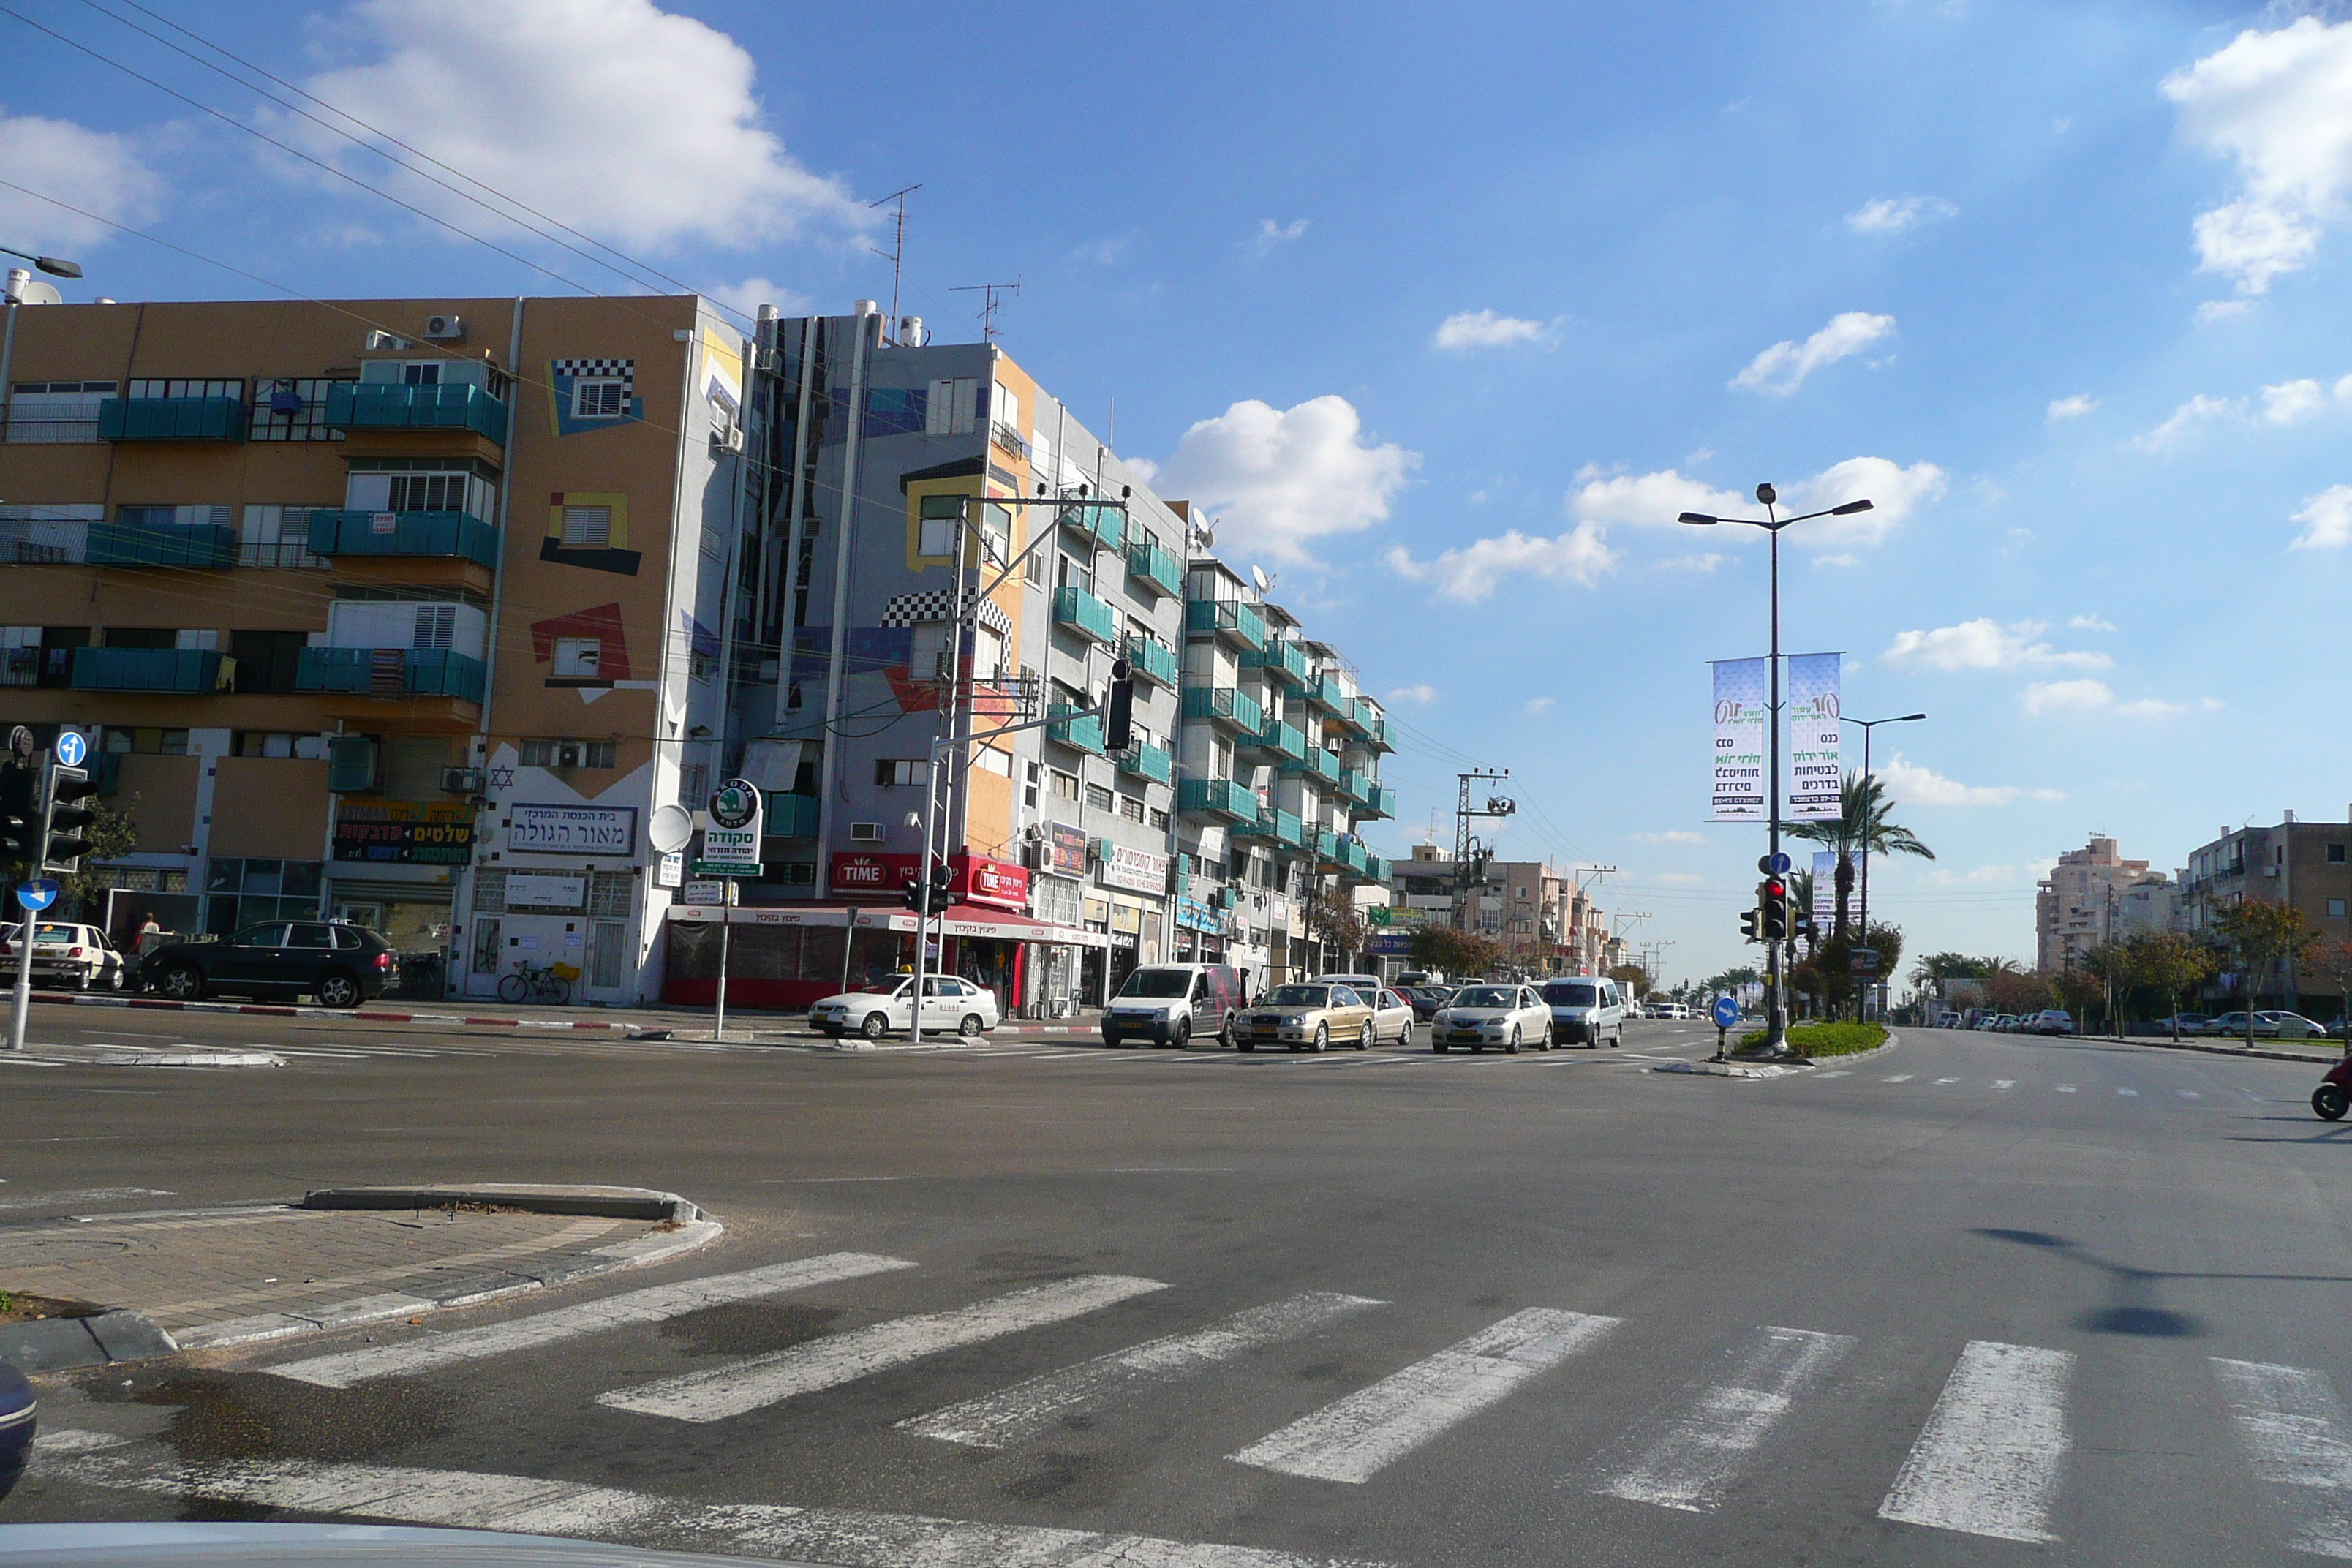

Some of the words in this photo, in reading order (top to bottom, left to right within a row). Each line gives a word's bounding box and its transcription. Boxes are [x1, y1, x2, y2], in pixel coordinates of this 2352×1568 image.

[1792, 714, 1806, 722] ירוק
[1820, 734, 1838, 744] כנס
[1793, 750, 1817, 763] ירוק
[1819, 749, 1839, 761] אור
[1794, 763, 1838, 776] לבטיחות
[1802, 780, 1839, 790] בדרכים
[525, 810, 558, 818] המרכזי
[562, 811, 595, 821] הכנסת
[599, 813, 616, 821] בית
[719, 818, 745, 827] AUTO
[339, 823, 402, 843] מדבקות
[514, 819, 569, 842] הגולה
[578, 825, 624, 844] מאור
[708, 832, 754, 846] סקודה
[367, 845, 400, 860] דפוס
[412, 846, 468, 863] חותמות
[1117, 848, 1150, 872] קומפרסורים
[843, 867, 880, 881] TIME
[900, 866, 923, 878] קיבוץ
[983, 872, 999, 889] TIME
[755, 913, 779, 921] בקיבוץ
[781, 914, 800, 922] פיצוץ
[954, 924, 976, 932] בקיבוץ
[979, 925, 996, 934] פיצוץ
